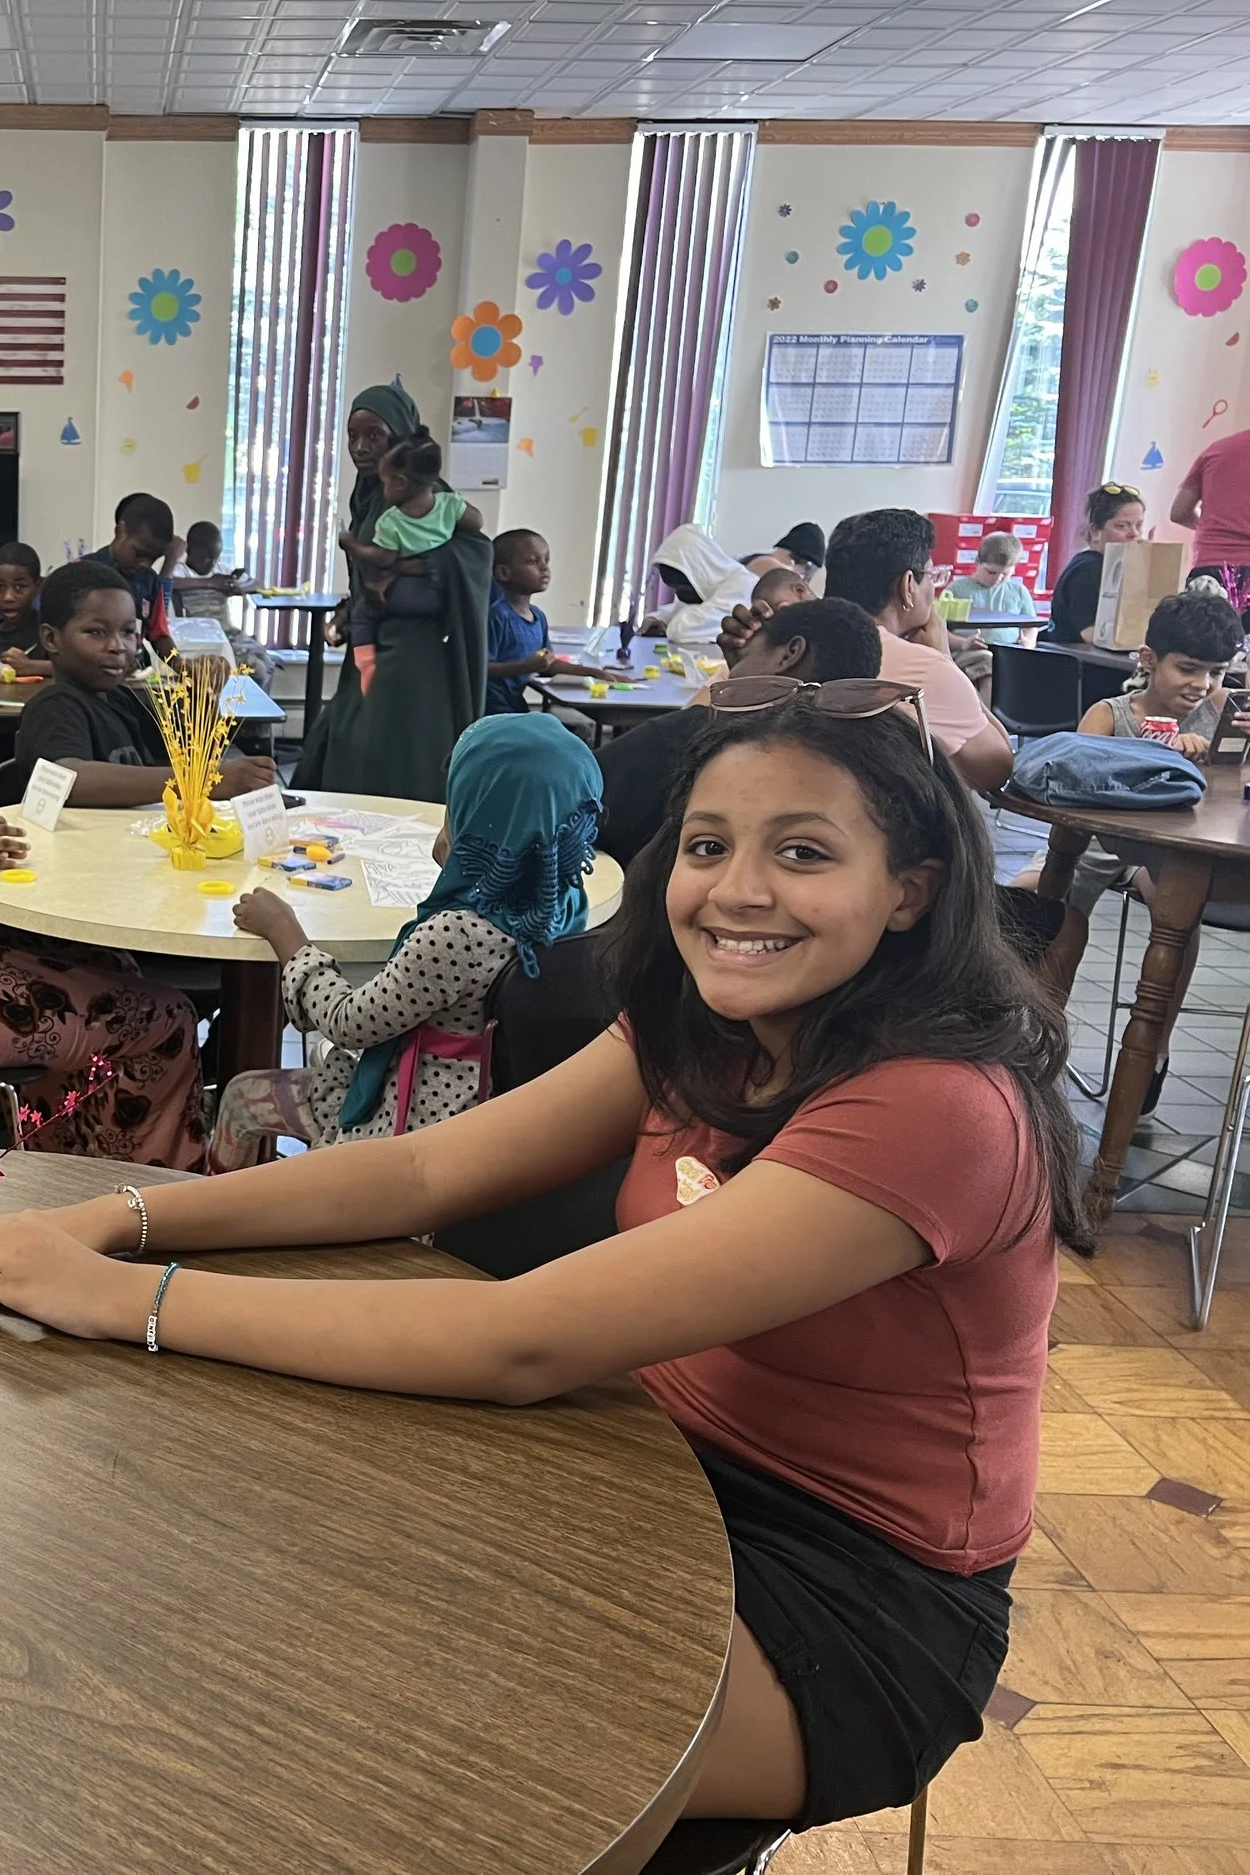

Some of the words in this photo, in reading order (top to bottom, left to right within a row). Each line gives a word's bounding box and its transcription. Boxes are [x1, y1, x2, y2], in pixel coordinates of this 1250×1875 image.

[772, 335, 798, 344] 2022
[798, 335, 839, 345] Monthly
[840, 335, 883, 345] Planning
[884, 335, 929, 344] Calendar
